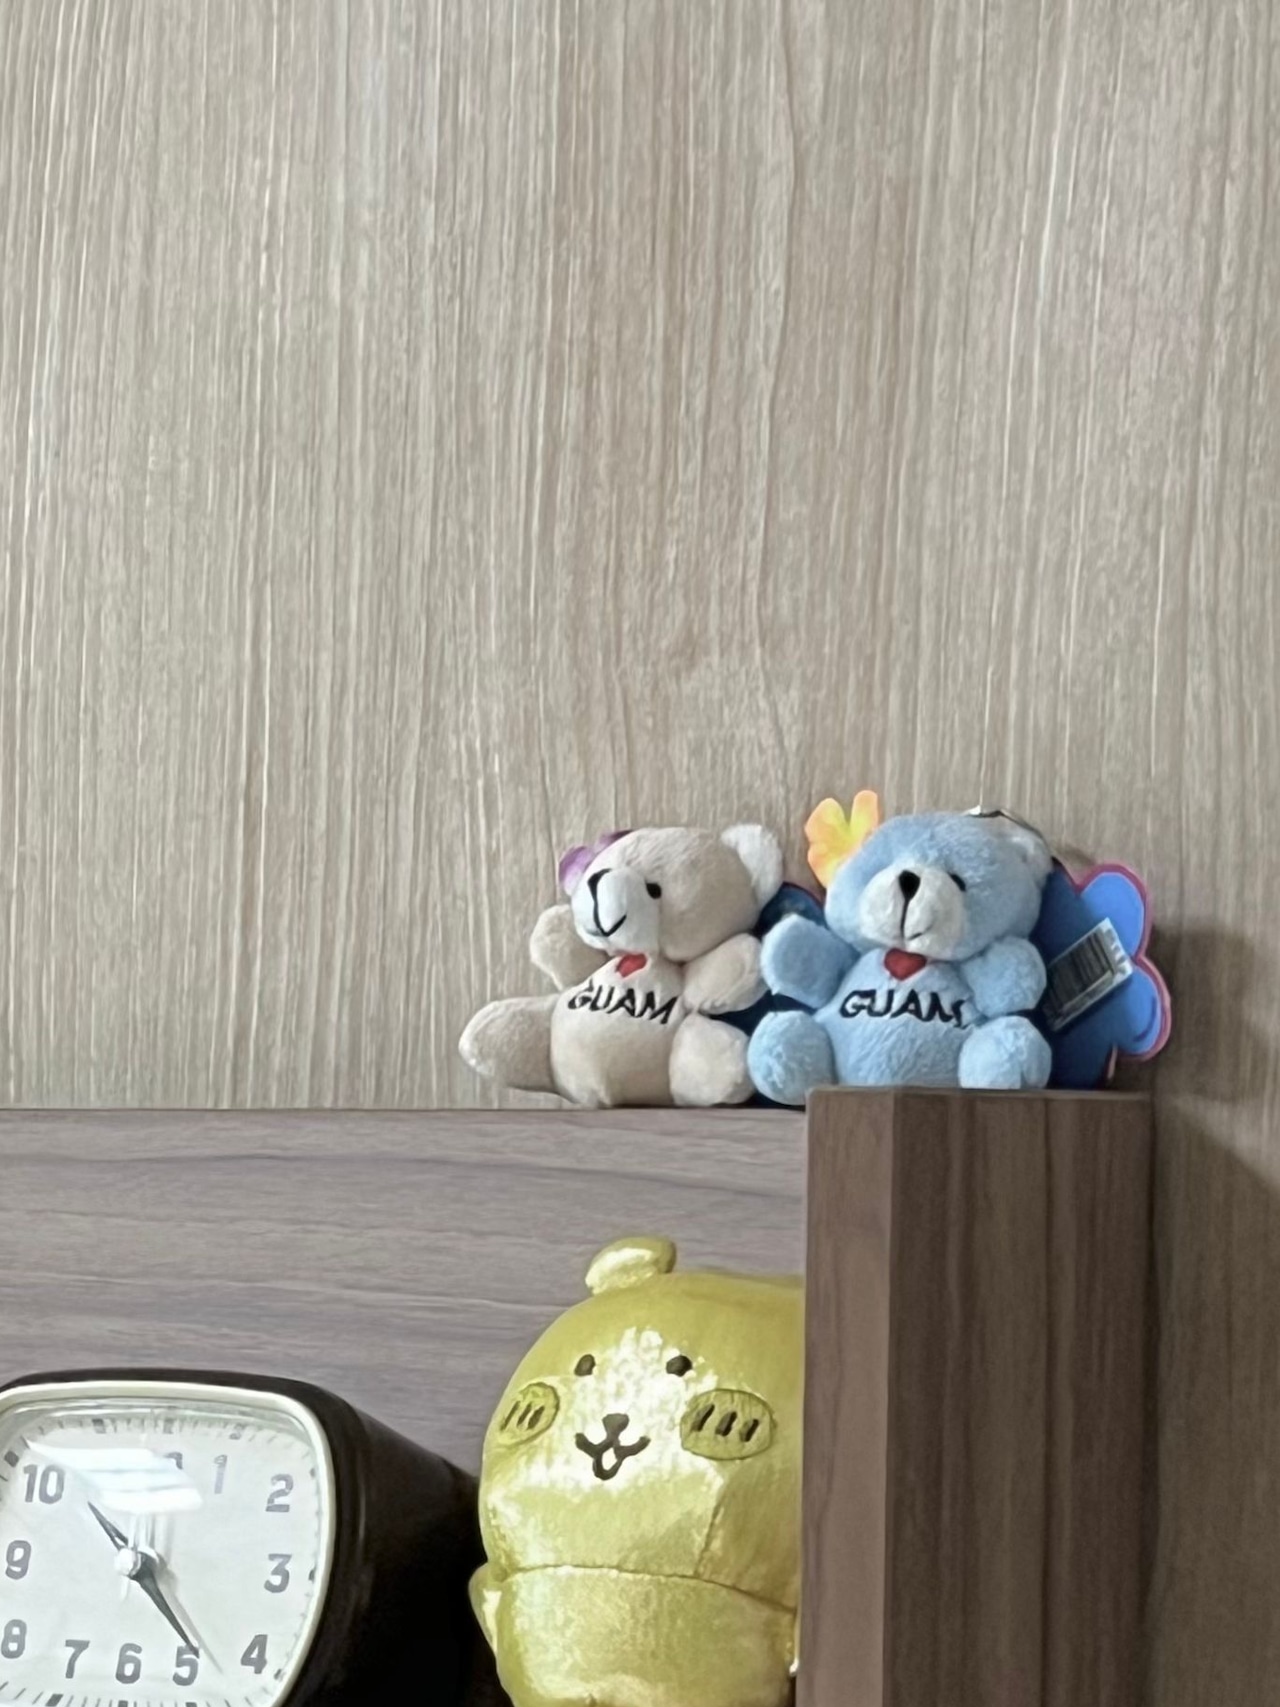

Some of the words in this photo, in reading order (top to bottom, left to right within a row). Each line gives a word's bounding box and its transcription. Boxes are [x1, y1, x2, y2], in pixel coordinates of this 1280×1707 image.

[568, 981, 680, 1025] GUAM
[24, 1464, 65, 1504] 10
[266, 1473, 293, 1512] 2
[6, 1540, 31, 1580] 9
[264, 1553, 291, 1593] 3
[1, 1619, 27, 1659] 8
[64, 1639, 90, 1679] 7
[241, 1634, 269, 1675] 4
[116, 1643, 142, 1684] 6
[173, 1646, 199, 1686] 5
